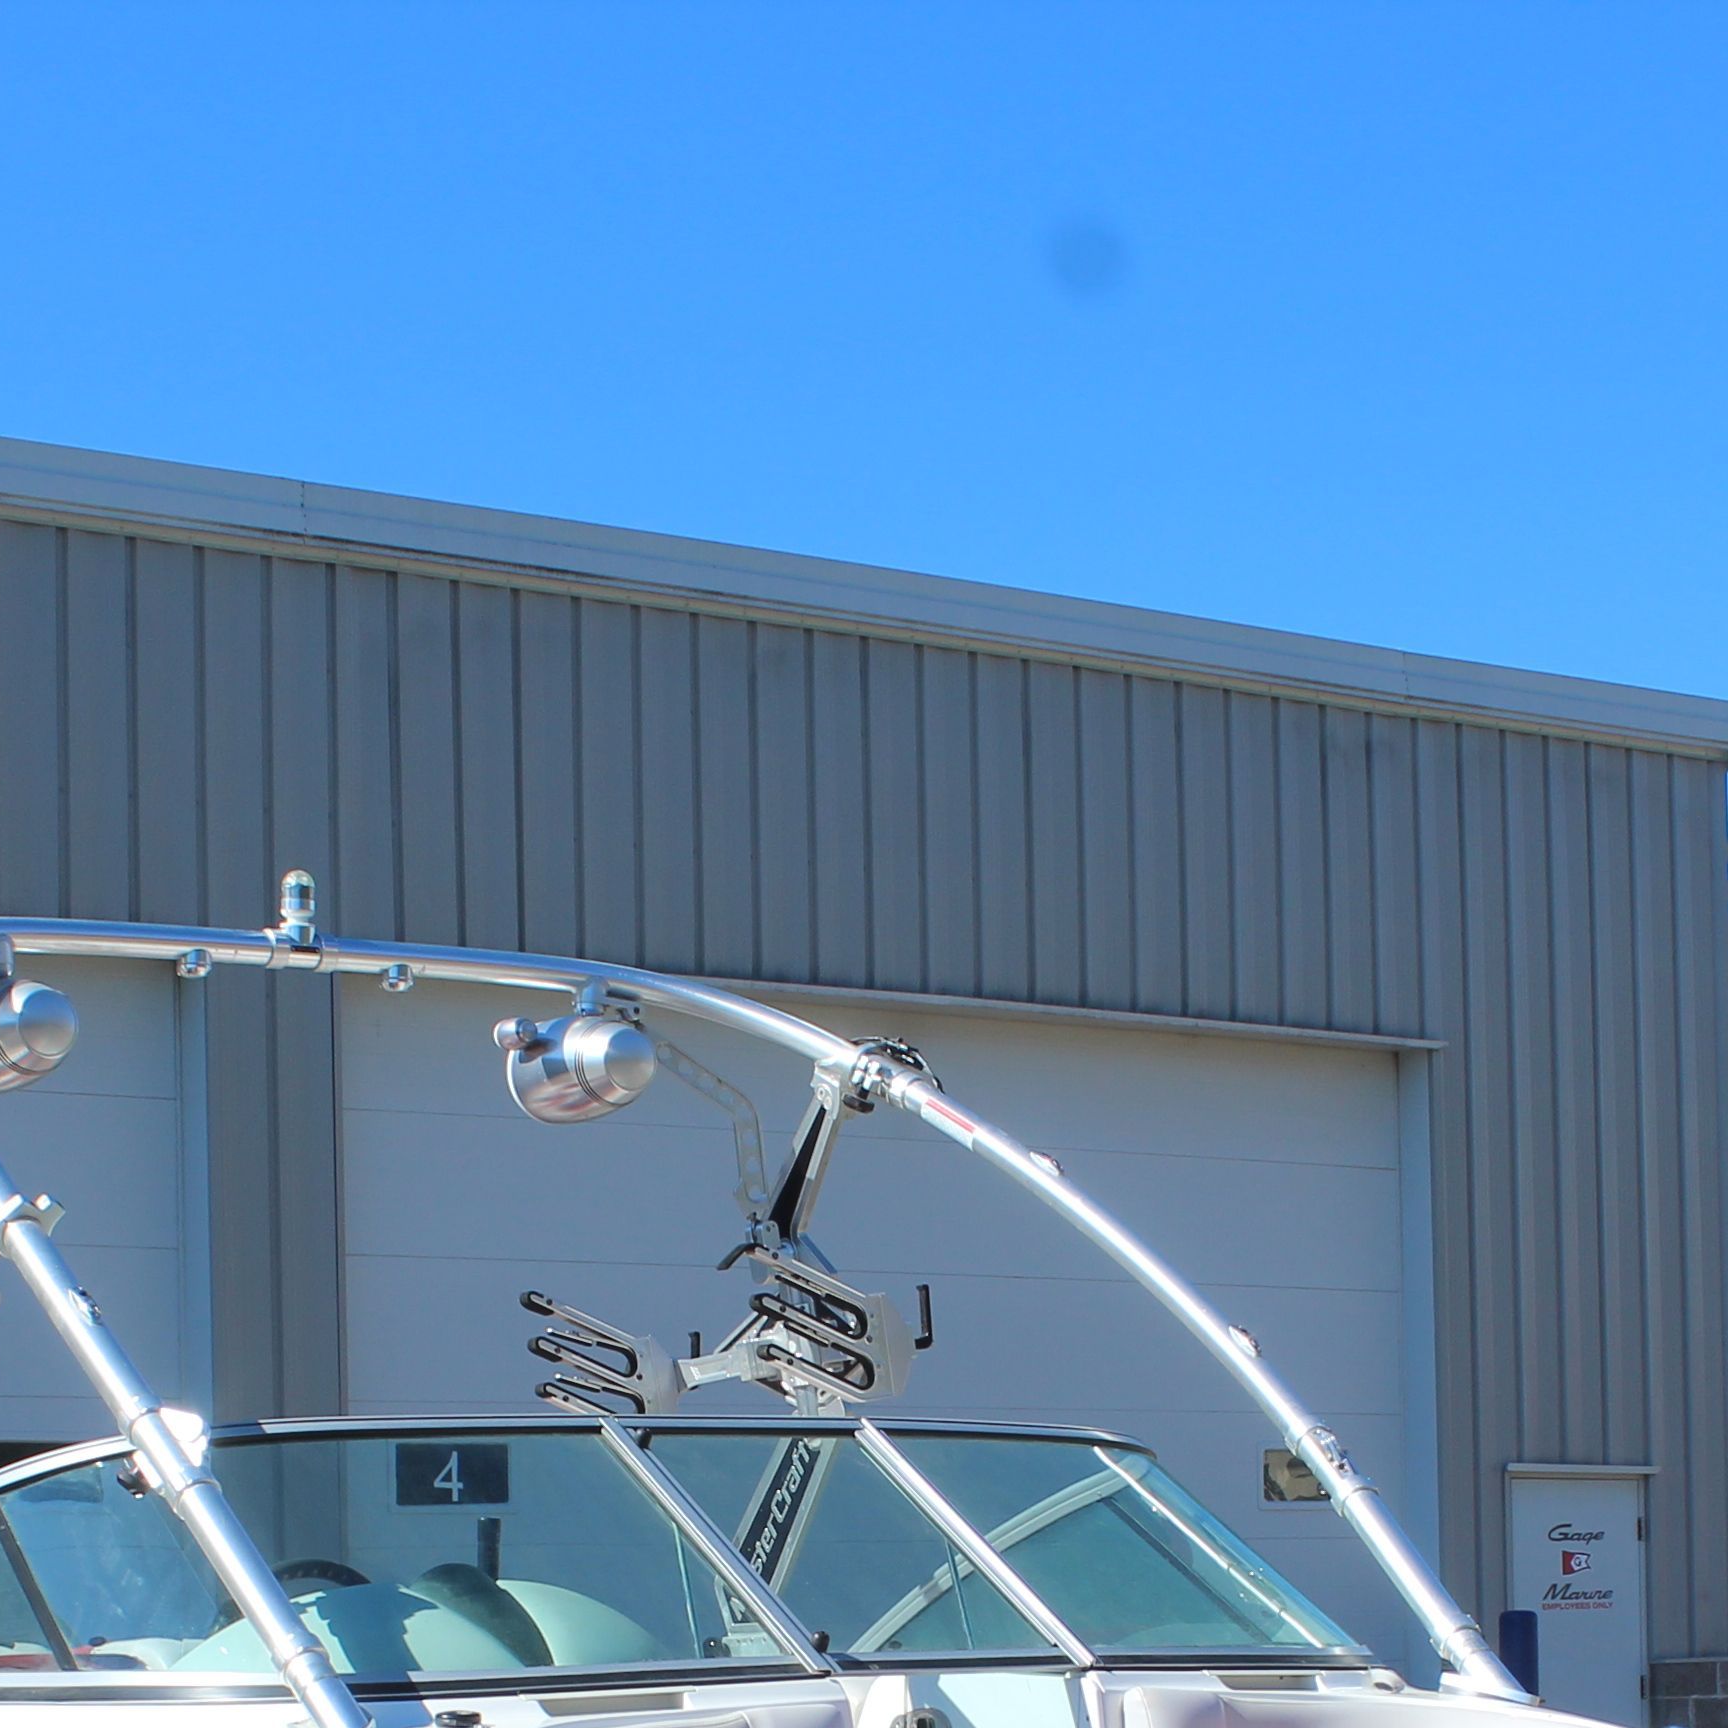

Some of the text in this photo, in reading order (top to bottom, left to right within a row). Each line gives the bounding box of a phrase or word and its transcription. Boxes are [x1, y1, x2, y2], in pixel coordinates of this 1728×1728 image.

[433, 1450, 464, 1502] 4
[1547, 1523, 1606, 1546] Gage
[1542, 1583, 1614, 1601] Marine
[1541, 1601, 1614, 1611] EMPLOYEES ONLY
